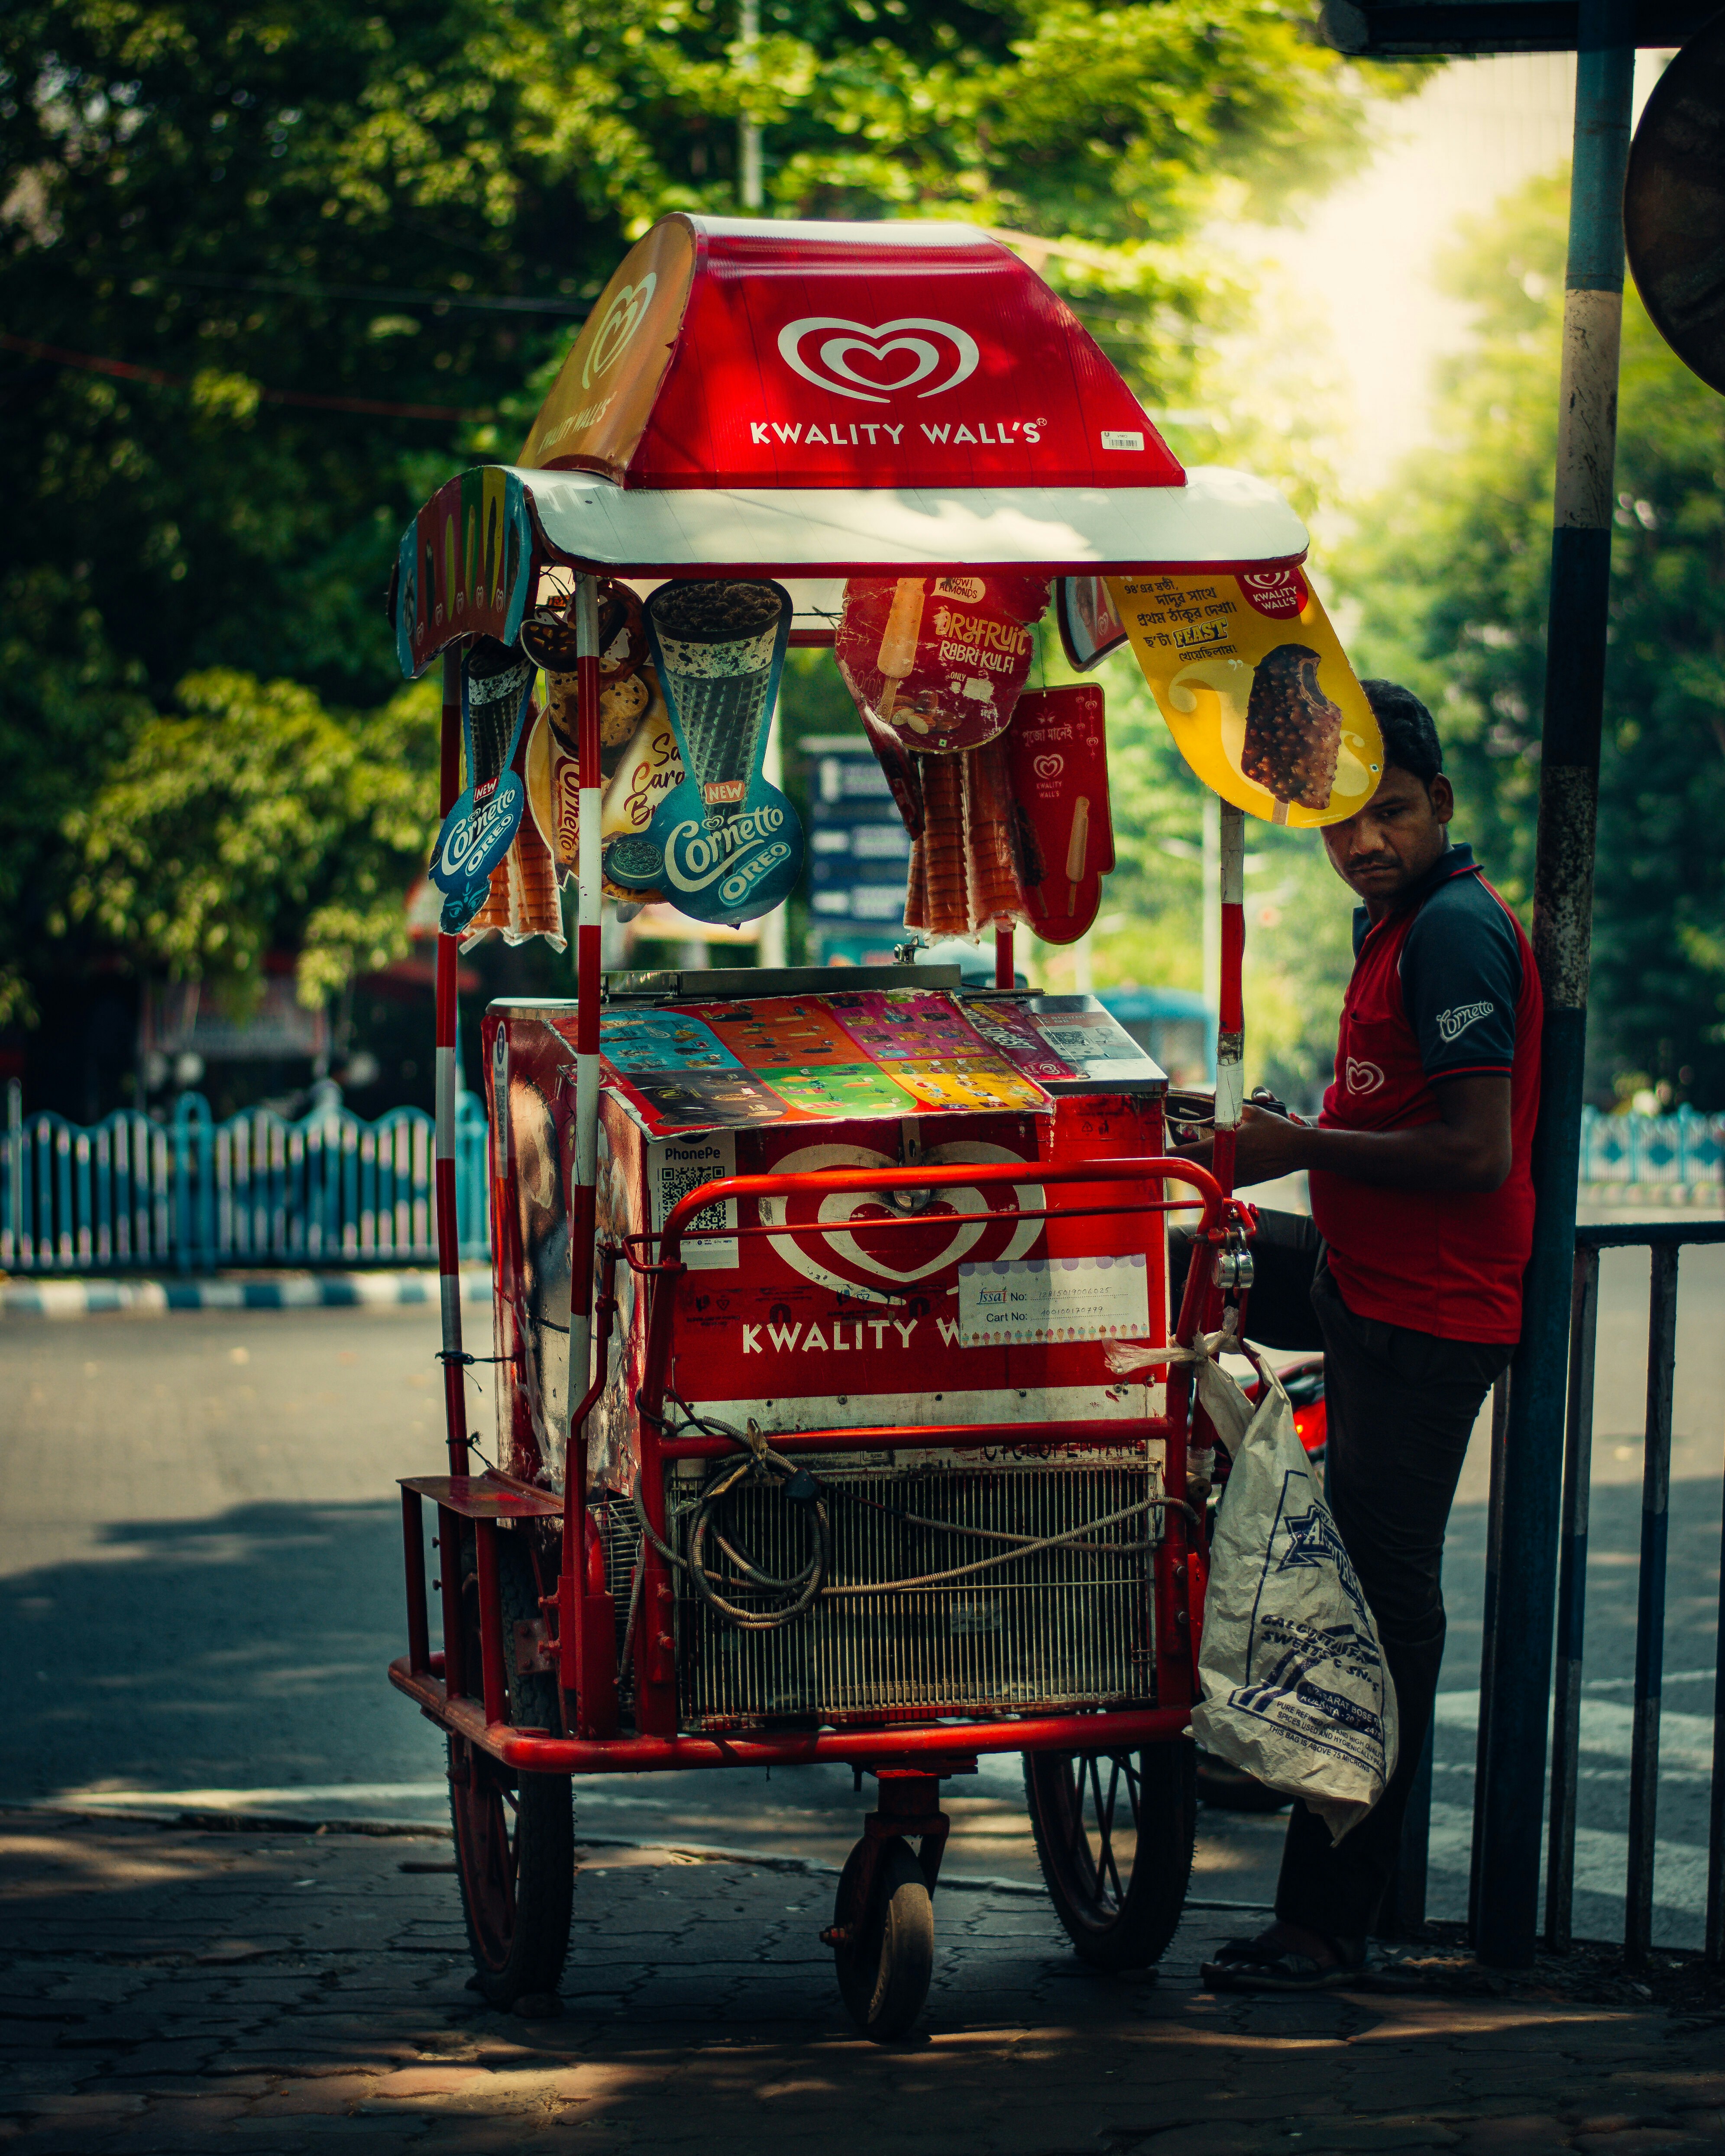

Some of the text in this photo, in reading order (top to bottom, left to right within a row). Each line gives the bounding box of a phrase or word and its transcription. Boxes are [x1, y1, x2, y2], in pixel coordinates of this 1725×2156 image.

[751, 422, 1041, 445] KWALITY WALL'S
[939, 582, 977, 599] ALMONDS
[1154, 587, 1217, 608] দাদুর সাথে
[1252, 586, 1297, 602] KWALITY
[1261, 597, 1297, 610] WALL'S
[1136, 611, 1166, 627] প্রথম
[1166, 607, 1202, 623] ঠাকুর
[1173, 618, 1228, 649] FEAST
[950, 671, 966, 682] ONLY
[1048, 722, 1073, 741] মানেই
[476, 778, 497, 799] NEW
[708, 782, 742, 801] NEW
[1036, 780, 1062, 789] KWALITY
[441, 789, 515, 876] Cornetto
[467, 815, 512, 872] OREO
[665, 805, 783, 892] Cornetto
[722, 844, 787, 900] OREO
[1436, 1000, 1494, 1043] Cornetto
[664, 1146, 721, 1161] PhonePe
[977, 1286, 1008, 1304] fssai
[1011, 1293, 1027, 1301] No:
[986, 1312, 1009, 1322] Cart
[1011, 1312, 1028, 1322] No:
[742, 1319, 918, 1354] KWALITY
[1300, 1695, 1340, 1717] KOLKATA
[1322, 1694, 1350, 1710] SARAT
[1351, 1705, 1372, 1722] BOSE
[1276, 1701, 1295, 1713] PURE
[1295, 1709, 1323, 1726] REFINED
[1336, 1728, 1348, 1739] AND
[1349, 1735, 1365, 1746] HIGH
[1277, 1711, 1301, 1727] SPICES
[1301, 1722, 1318, 1735] USED
[1317, 1730, 1333, 1740] AND
[1333, 1735, 1373, 1761] HYGIENICALLY
[1269, 1724, 1370, 1773] THIS BAG IS ABOVE 75 MICRONS
